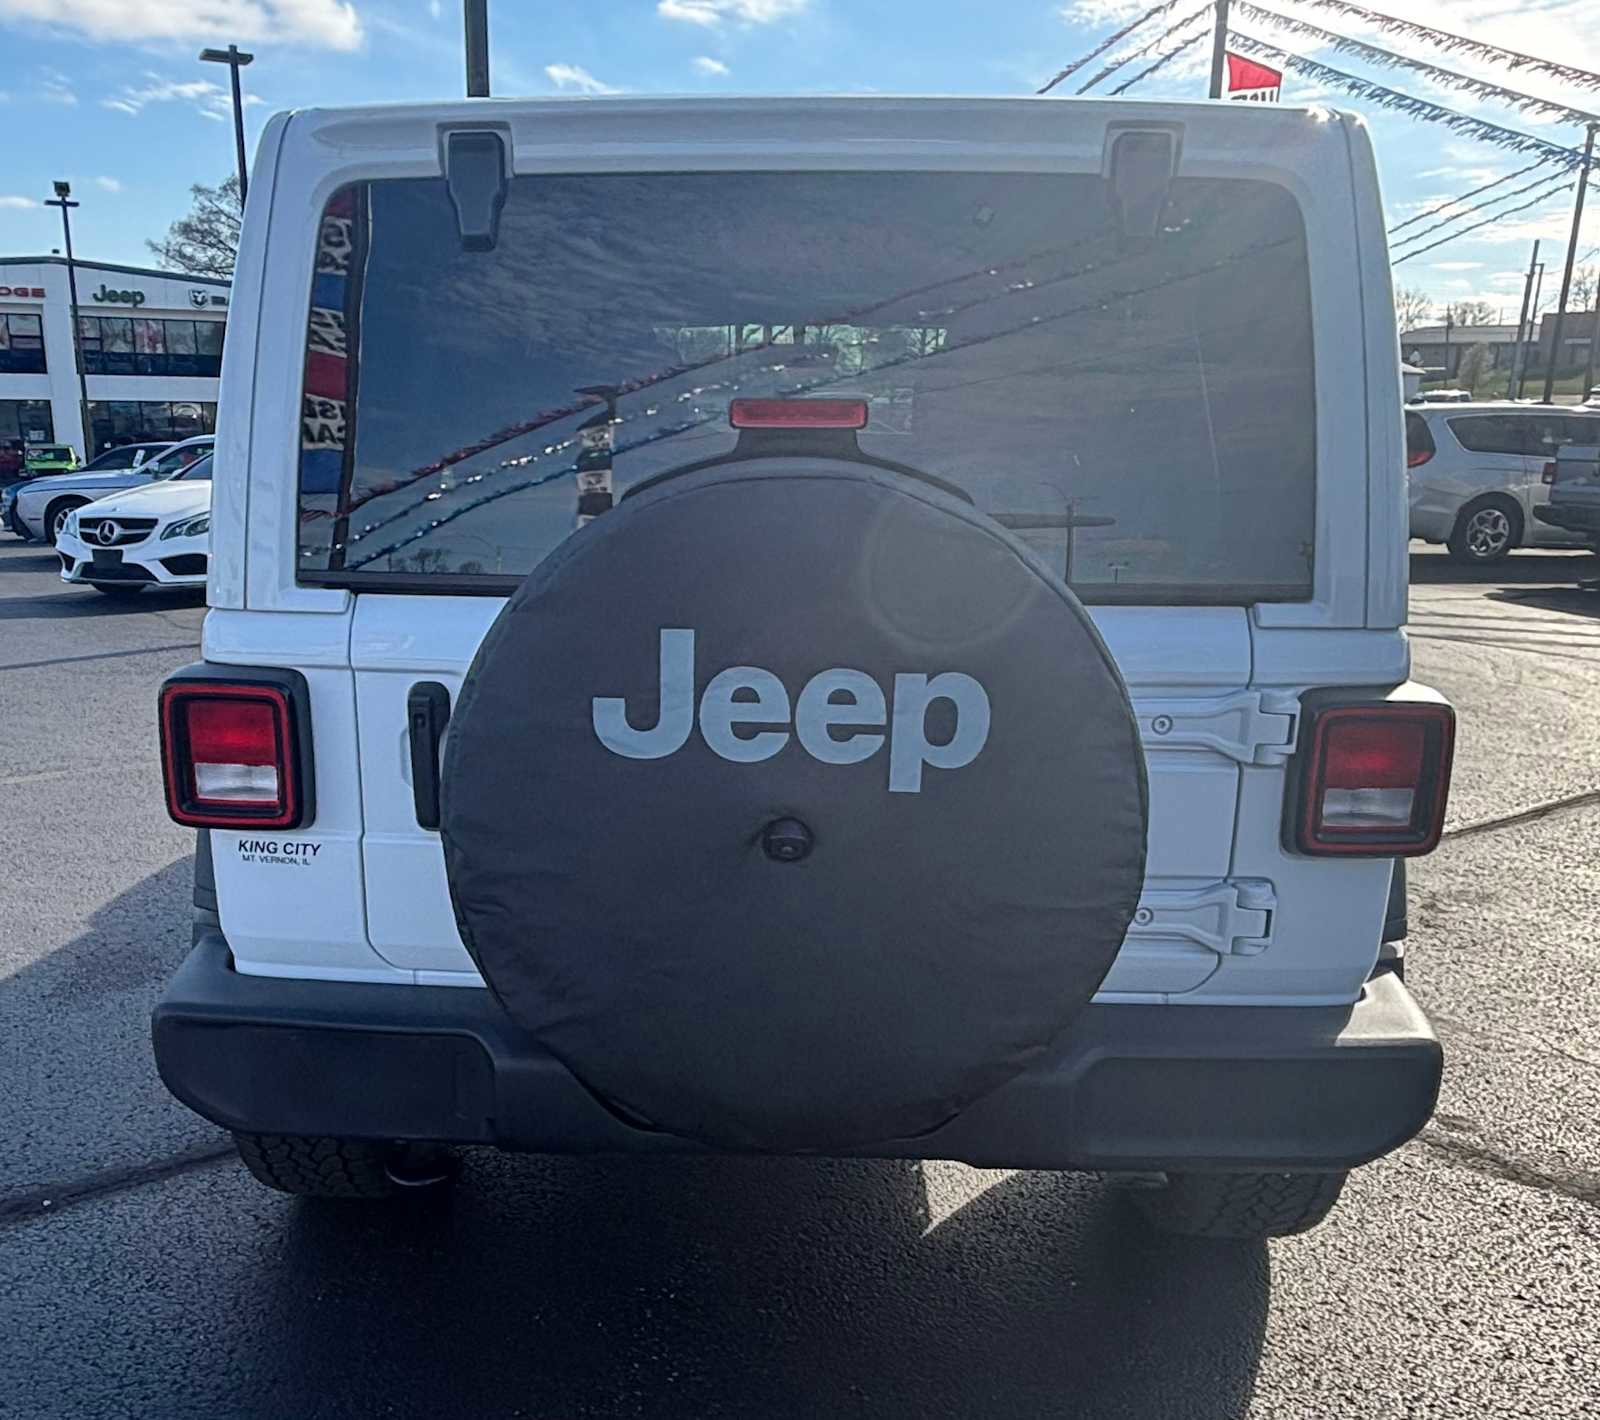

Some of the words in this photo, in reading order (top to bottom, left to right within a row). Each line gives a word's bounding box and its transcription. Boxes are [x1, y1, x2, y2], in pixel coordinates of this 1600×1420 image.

[92, 284, 145, 308] Jeep
[592, 628, 991, 793] Jeep
[238, 840, 278, 854] KING
[283, 842, 321, 856] CITY
